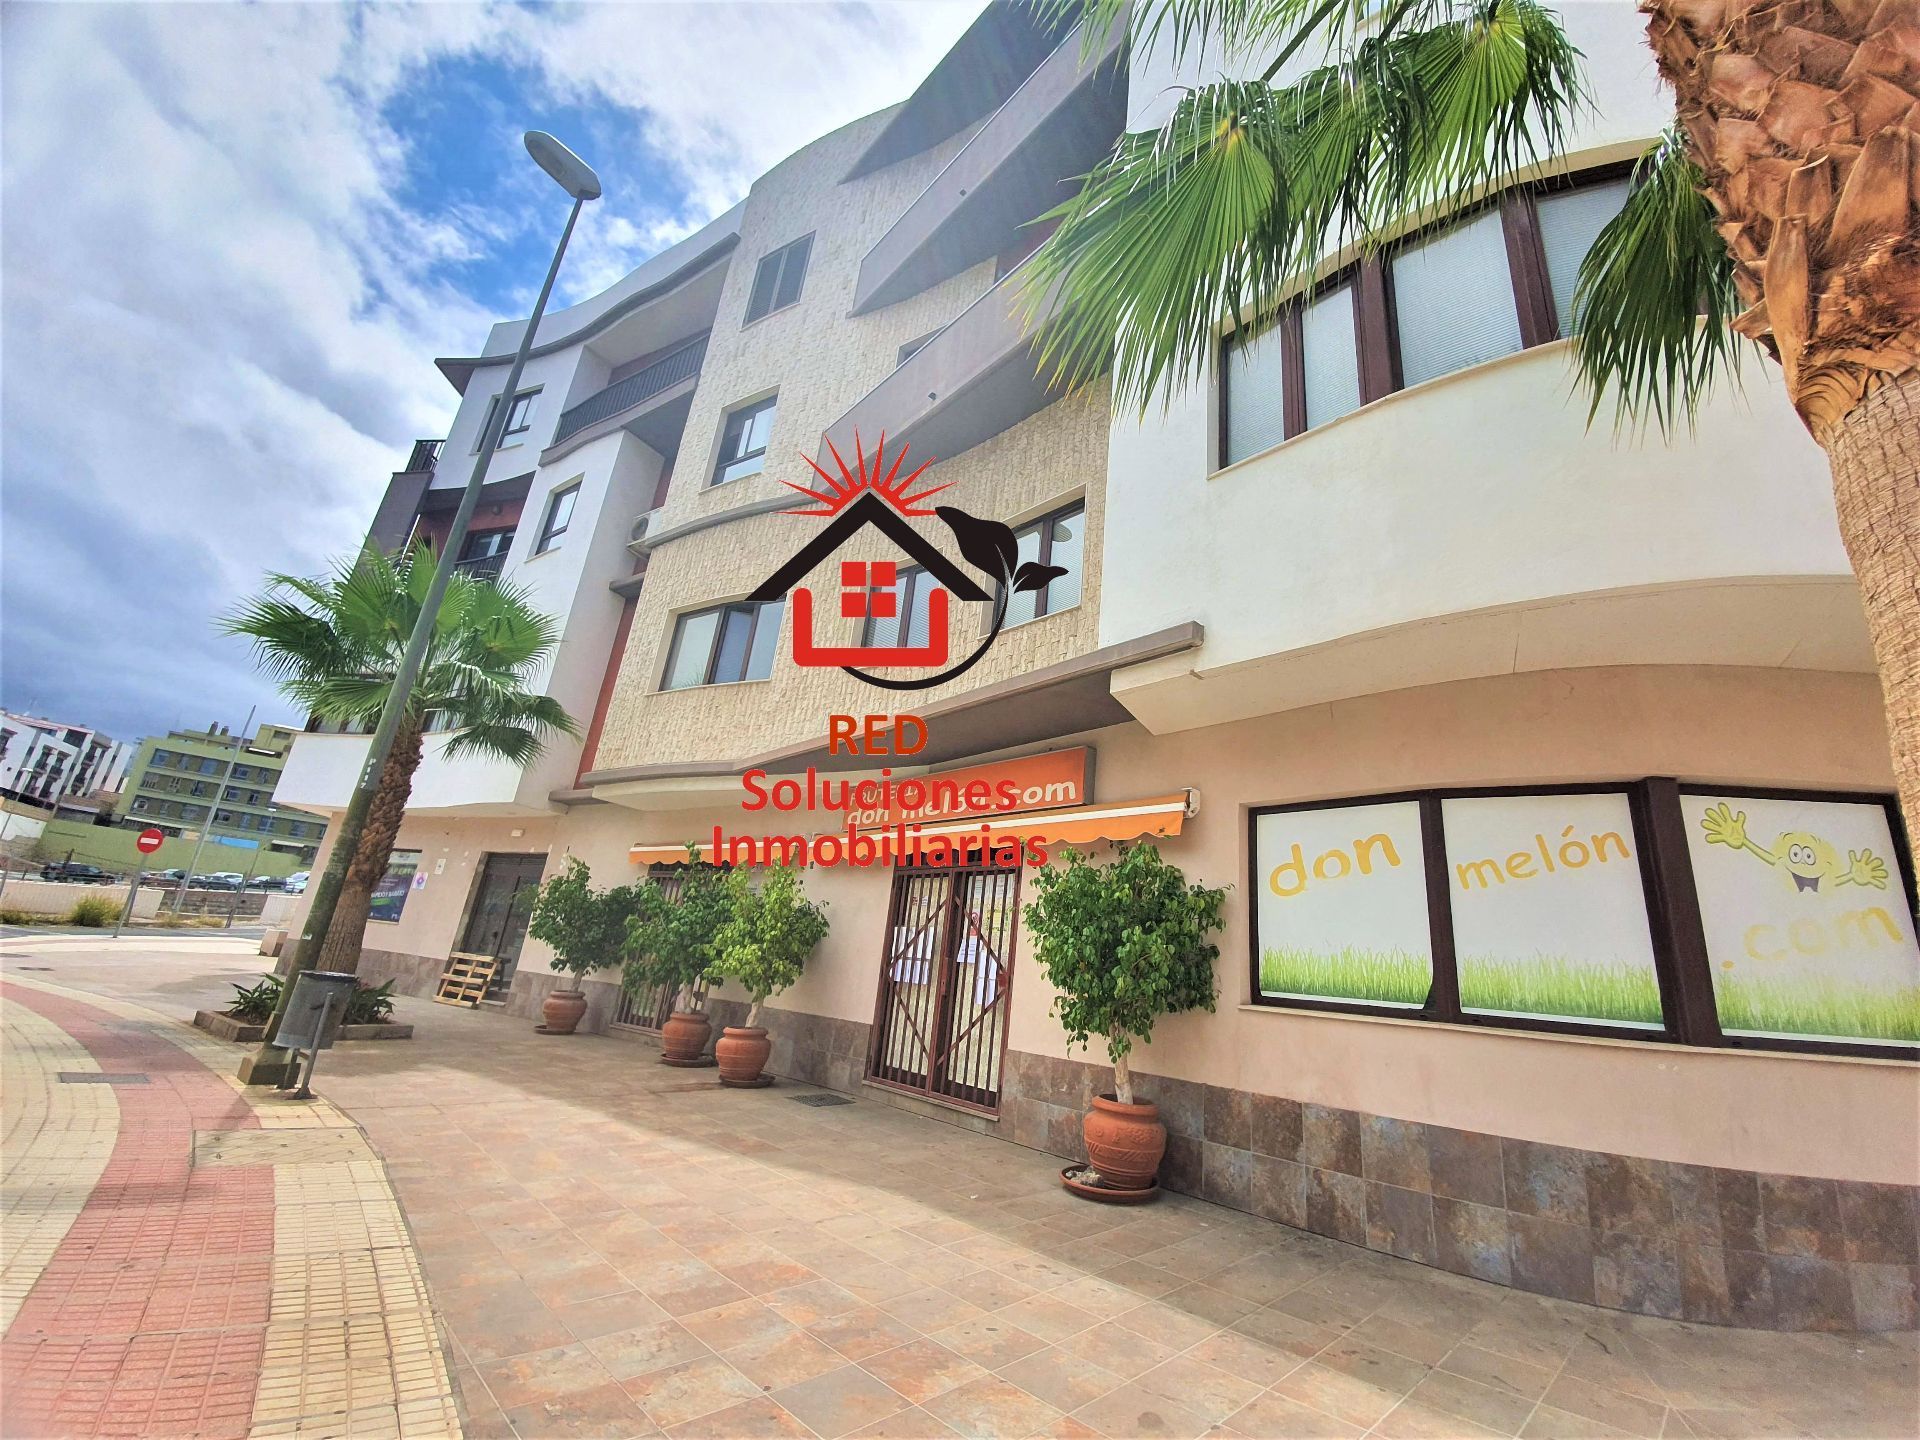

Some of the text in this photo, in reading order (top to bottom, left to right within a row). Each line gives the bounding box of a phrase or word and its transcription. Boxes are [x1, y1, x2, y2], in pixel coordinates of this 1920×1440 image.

[1269, 824, 1632, 898] don melón
[1721, 906, 1904, 971] .com
